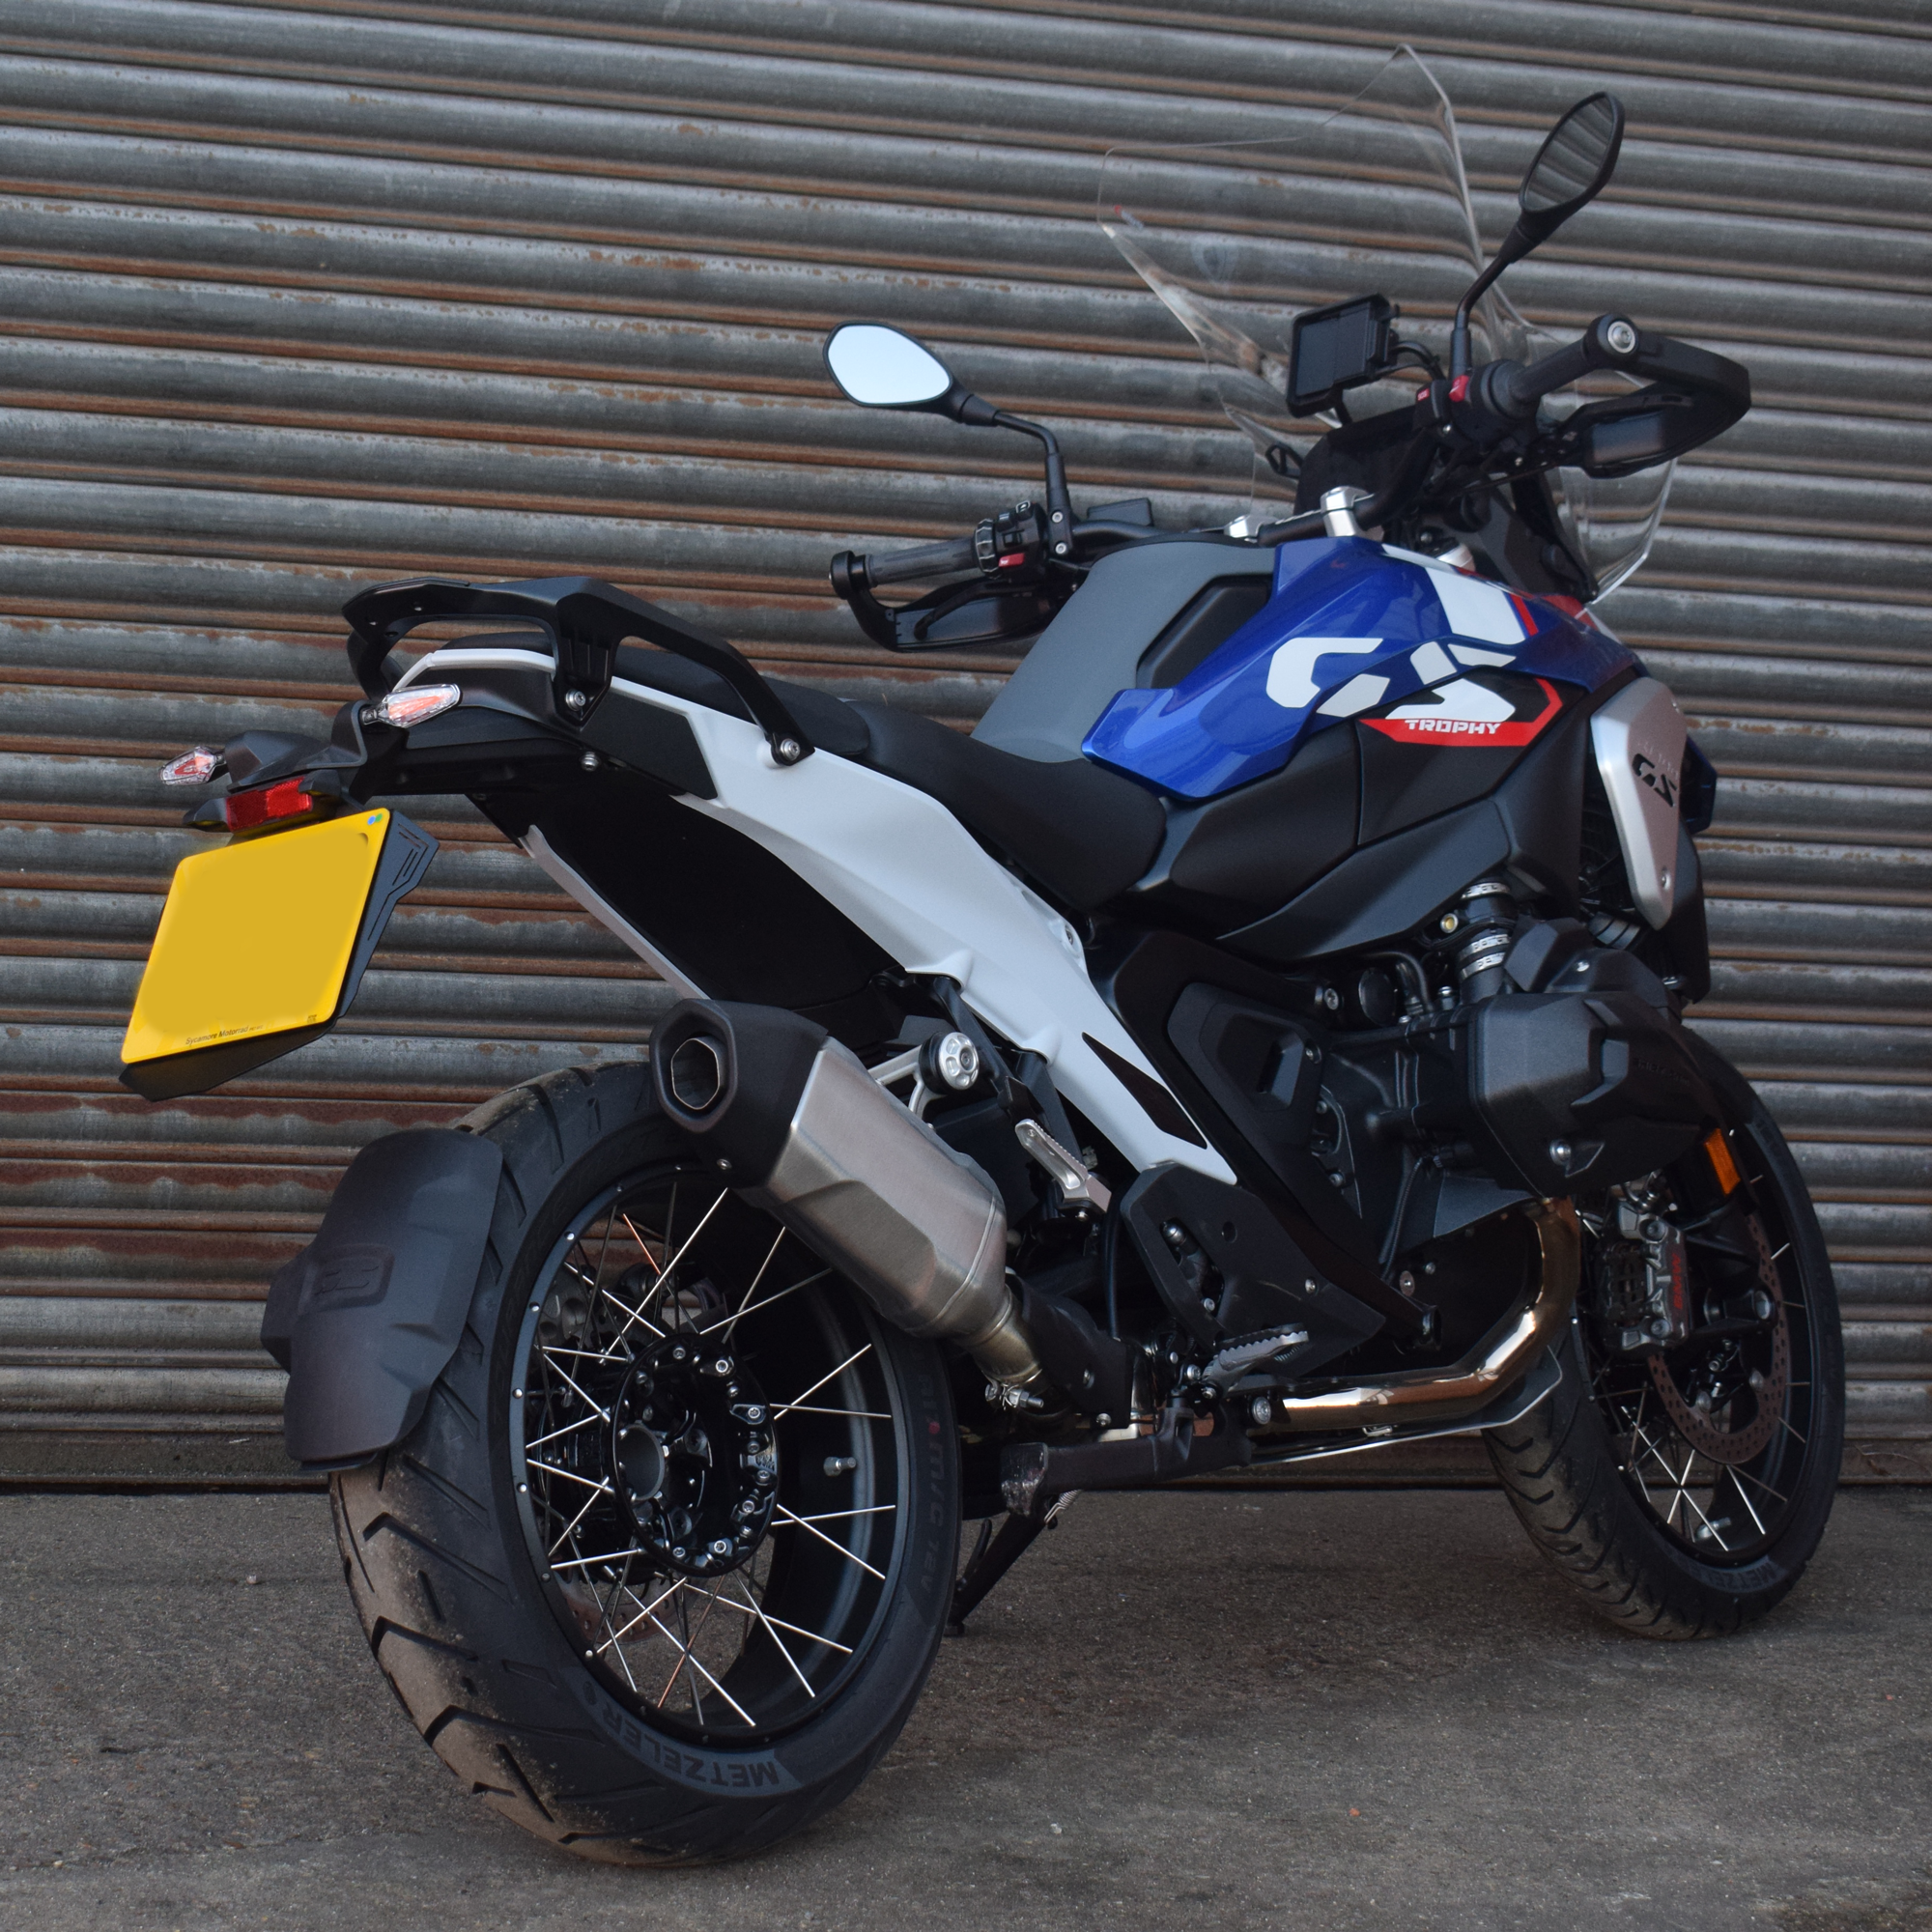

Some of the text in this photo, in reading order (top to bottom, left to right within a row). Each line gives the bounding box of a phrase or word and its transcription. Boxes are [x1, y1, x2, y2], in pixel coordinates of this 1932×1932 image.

[1405, 719, 1502, 734] TROPHY
[185, 1032, 218, 1045] Sycamore
[218, 1025, 250, 1038] Motorrad
[601, 1700, 781, 1788] METZELER
